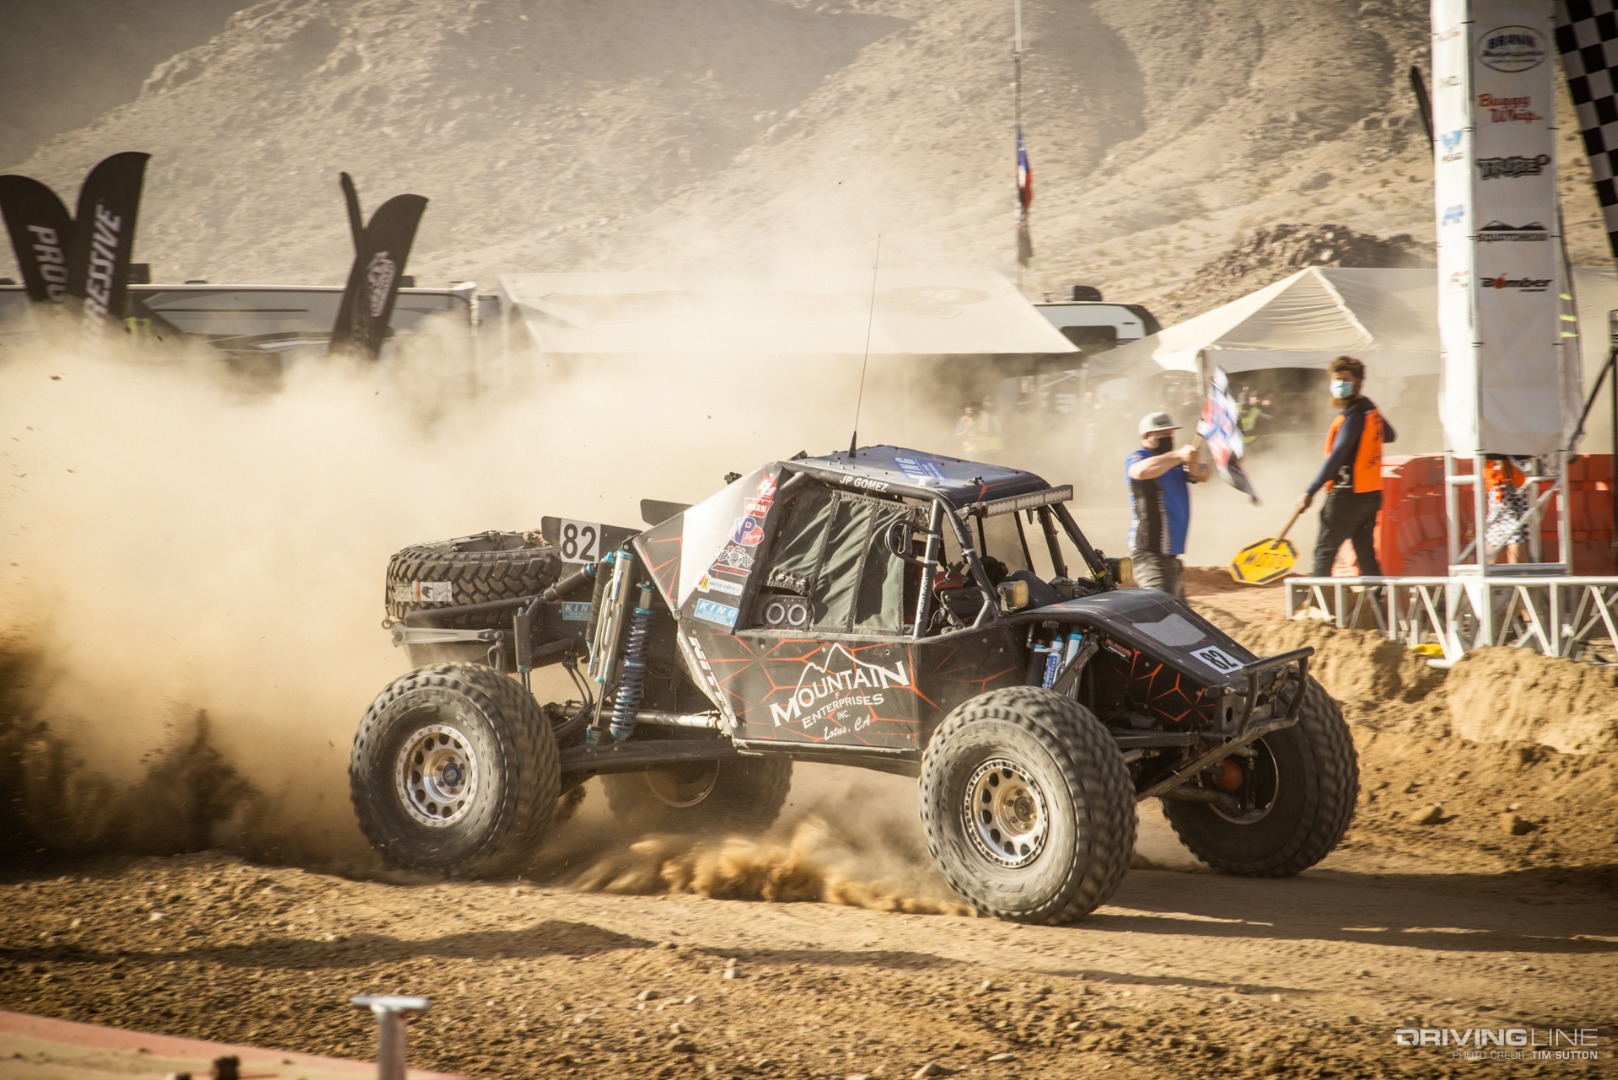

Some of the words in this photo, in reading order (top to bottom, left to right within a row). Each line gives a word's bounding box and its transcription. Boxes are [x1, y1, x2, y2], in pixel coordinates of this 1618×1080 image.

[839, 475, 854, 486] JP
[854, 476, 889, 493] GOMEZ
[746, 502, 767, 513] WARN
[562, 523, 597, 562] 82
[699, 601, 737, 617] KING
[1199, 649, 1239, 670] 82
[768, 659, 911, 728] MOUNTAIN
[801, 693, 885, 730] ENTERPRISES
[836, 710, 851, 721] INC.
[854, 714, 871, 732] CA
